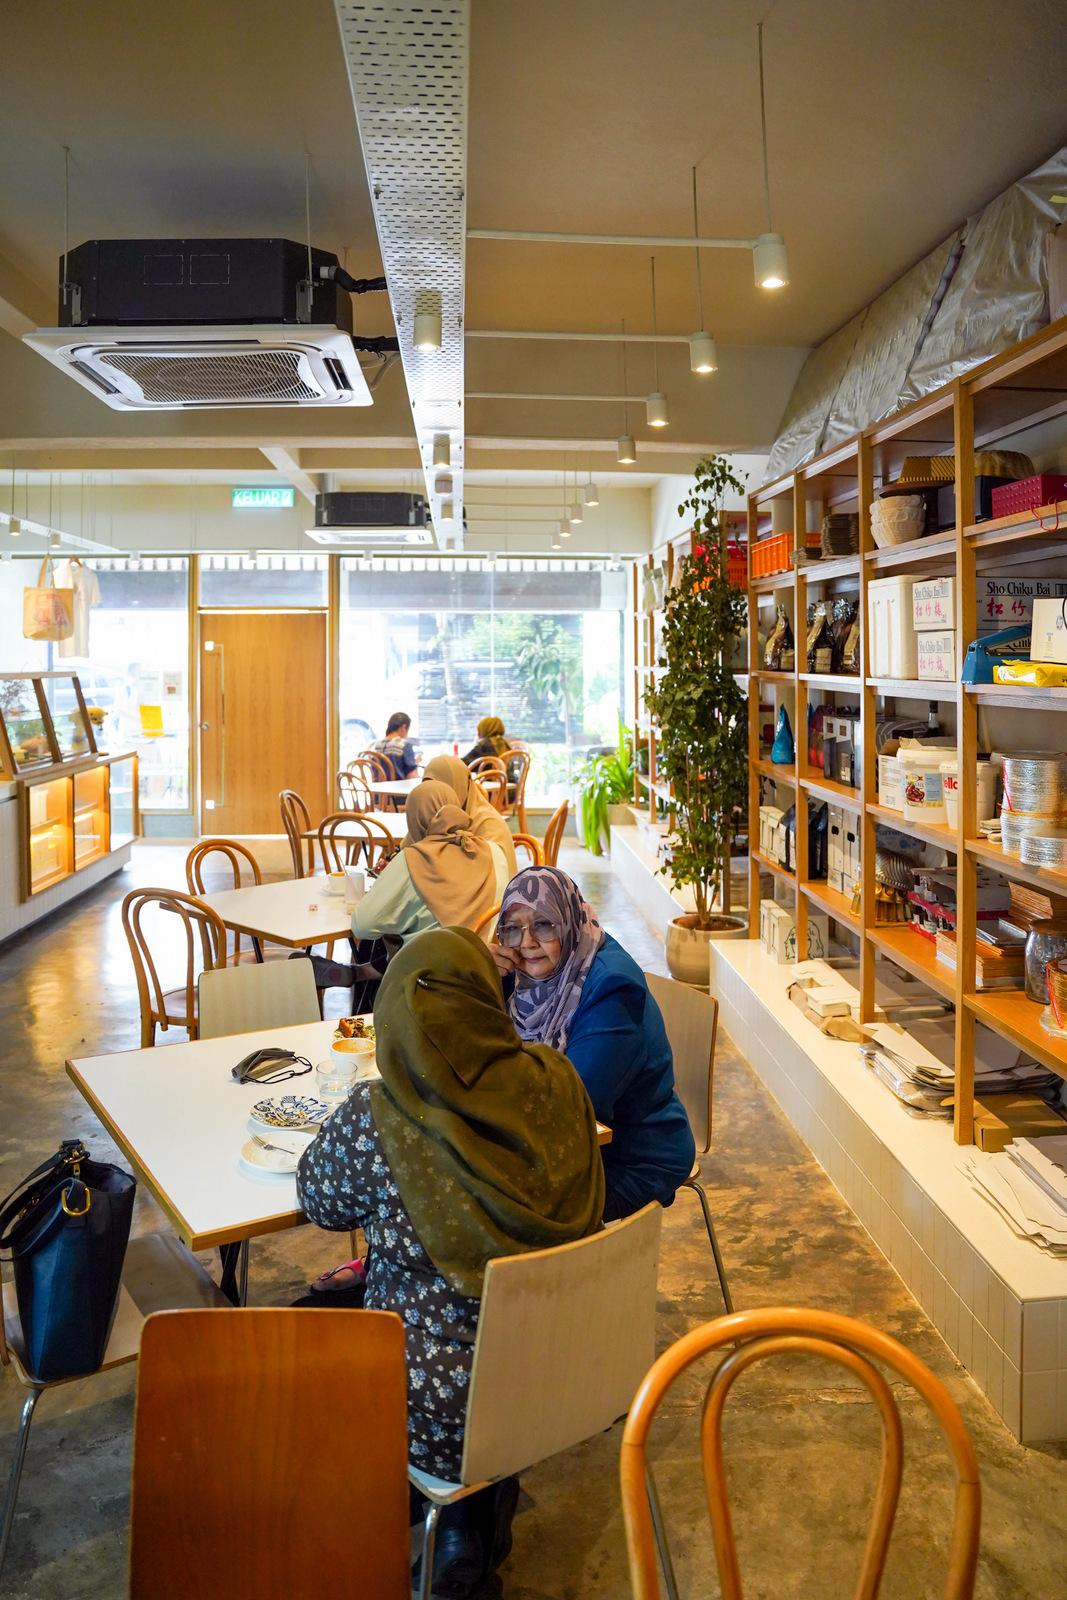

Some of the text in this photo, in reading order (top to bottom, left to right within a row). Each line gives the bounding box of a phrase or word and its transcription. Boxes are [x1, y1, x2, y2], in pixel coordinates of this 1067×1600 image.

[234, 491, 280, 505] KELUAR
[987, 581, 1051, 596] Sho Chiku Bai
